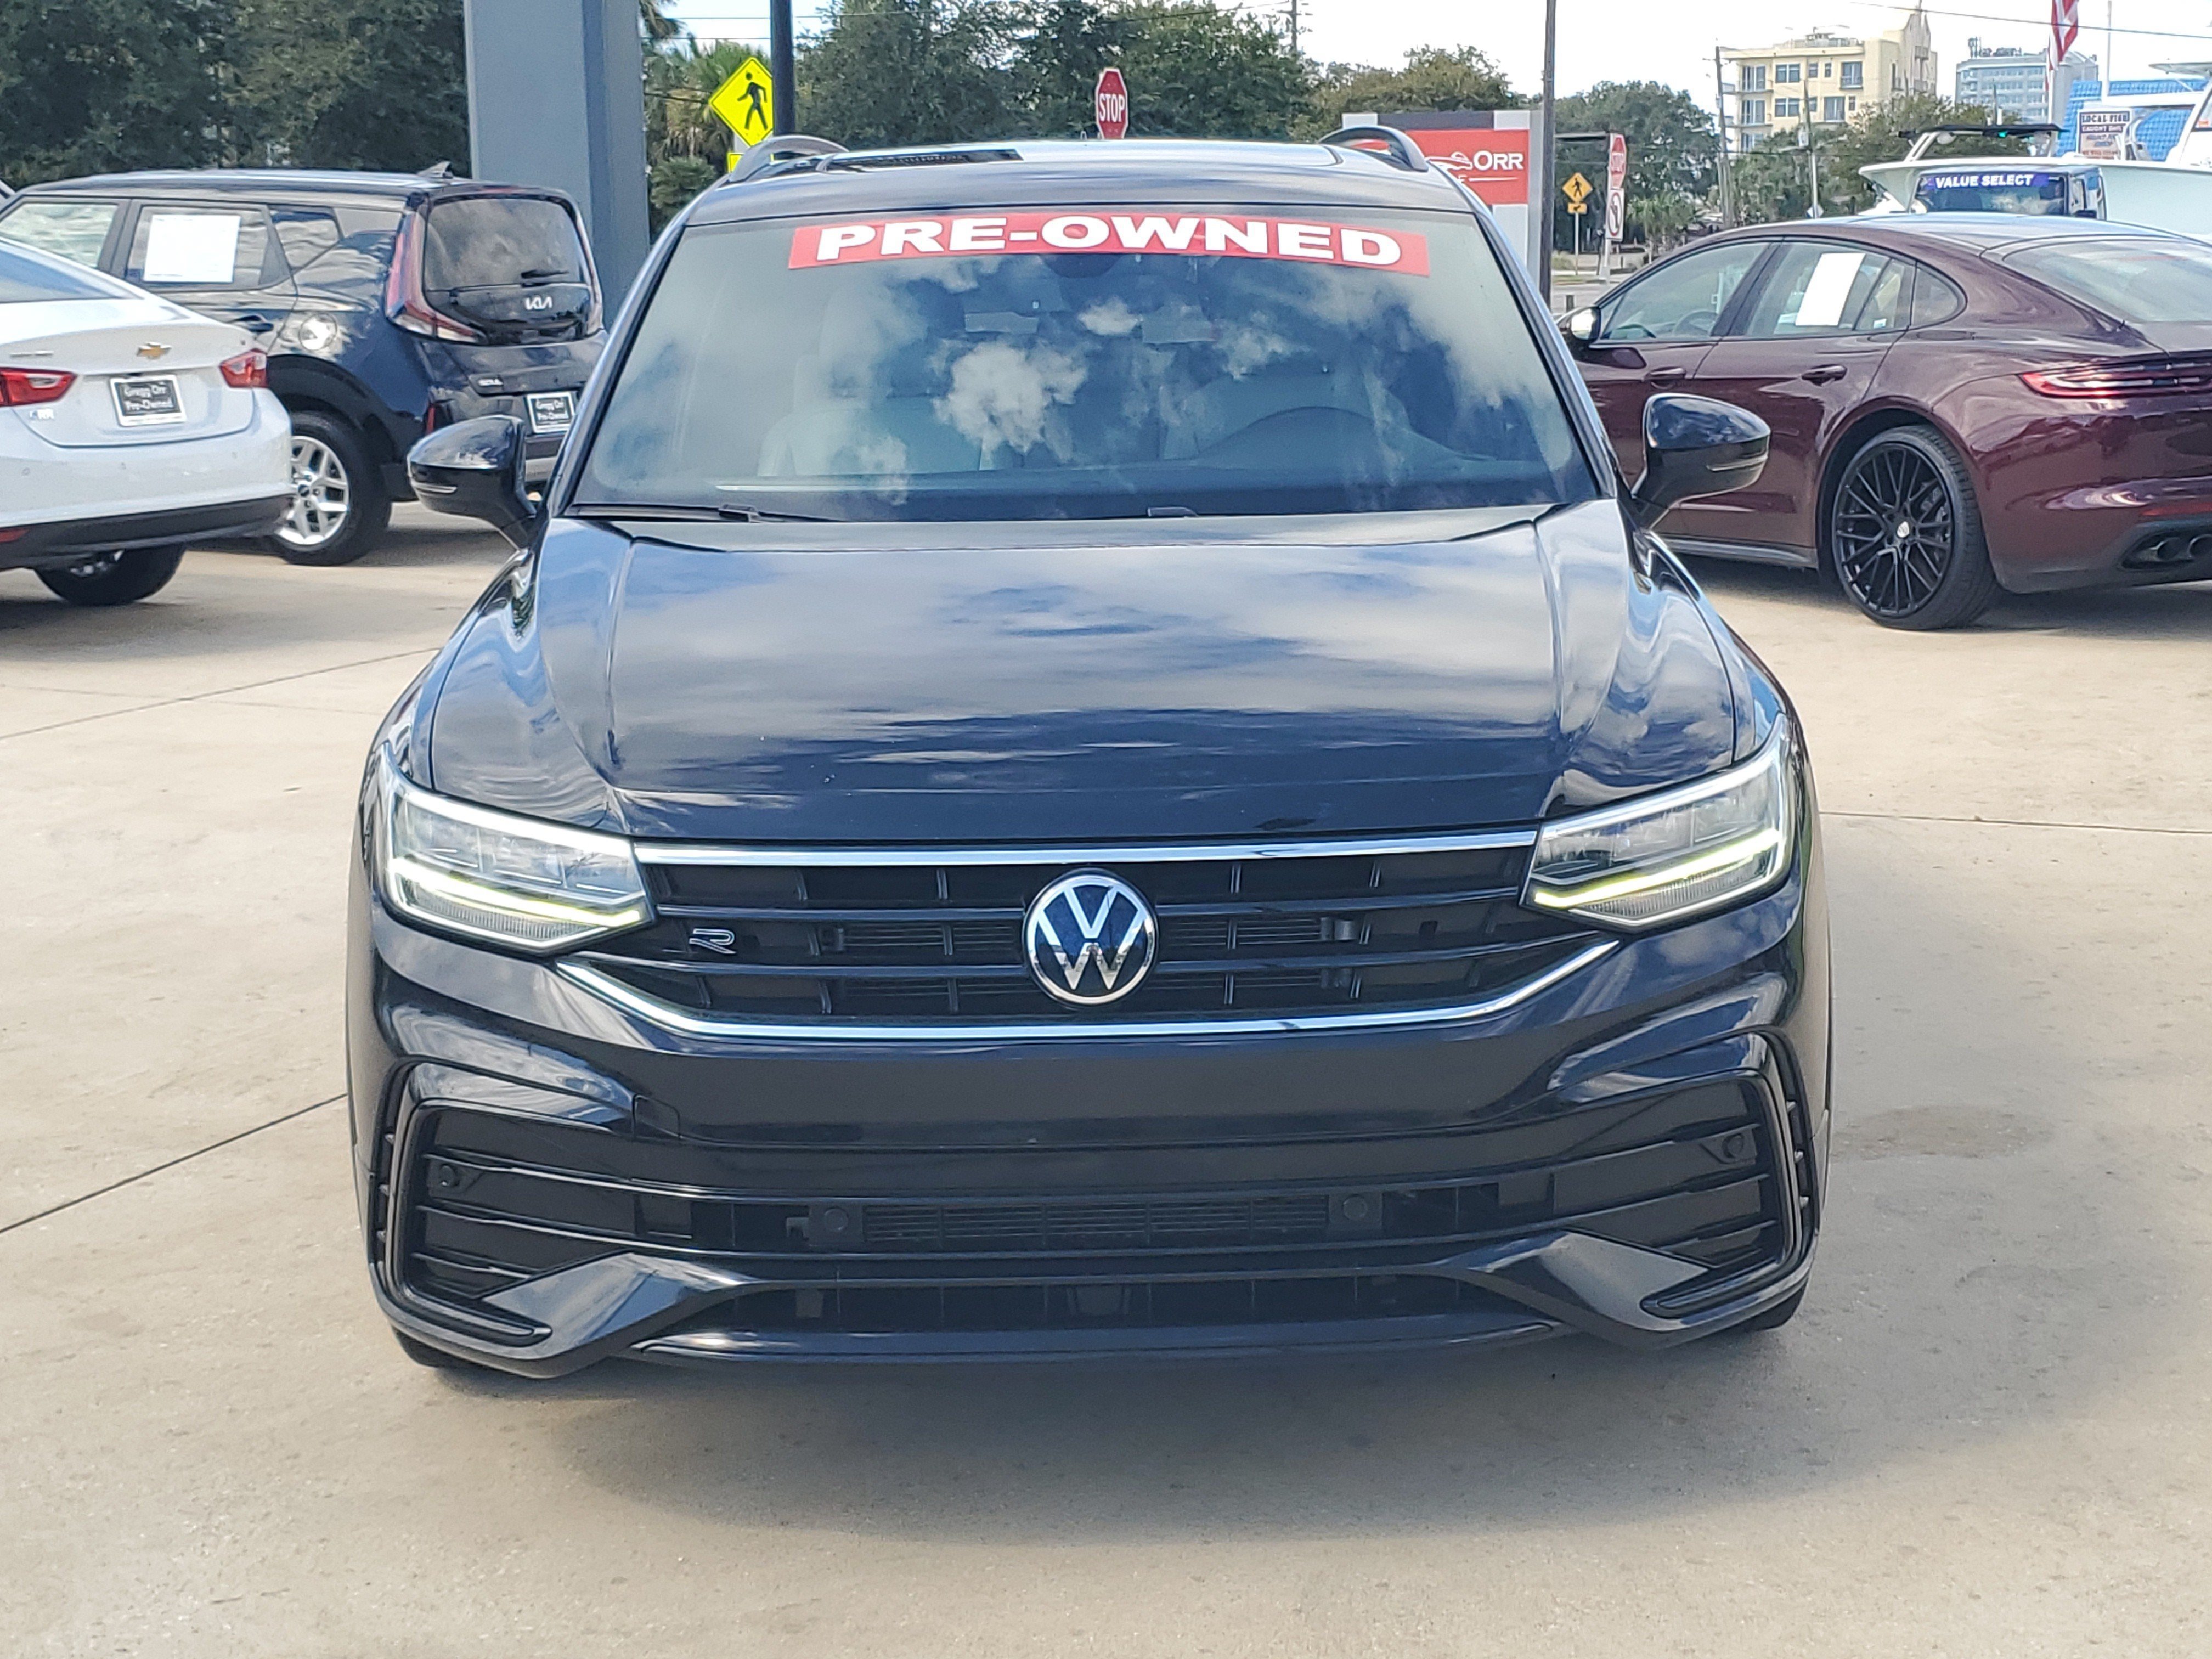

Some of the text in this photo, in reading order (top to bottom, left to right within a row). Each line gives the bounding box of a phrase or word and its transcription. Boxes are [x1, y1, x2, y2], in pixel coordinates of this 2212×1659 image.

[1099, 93, 1125, 122] STOP
[1473, 150, 1523, 171] ORR
[1936, 174, 2034, 188] VALUE SELECT
[816, 217, 1401, 265] PRE-OWNED
